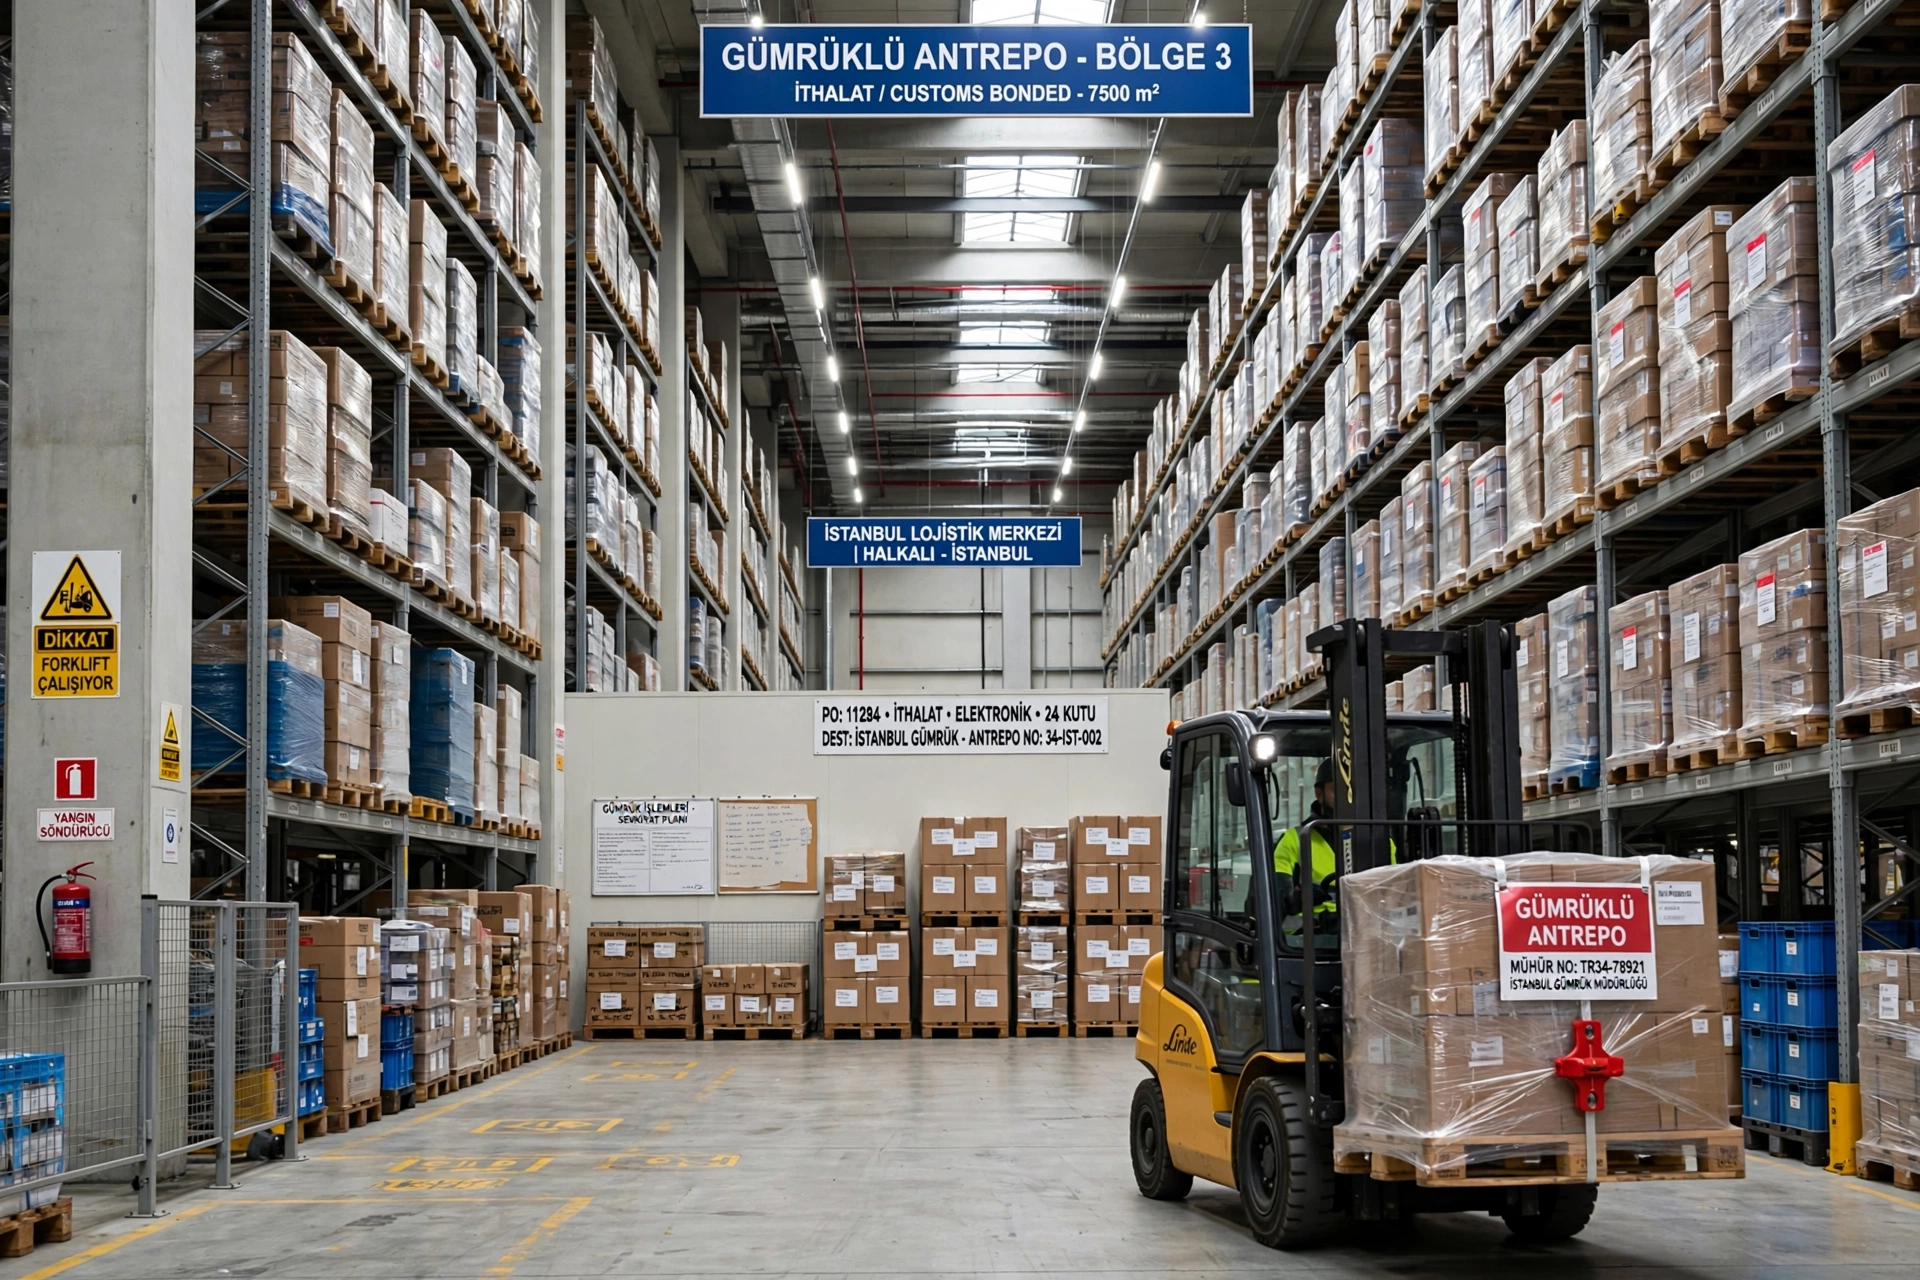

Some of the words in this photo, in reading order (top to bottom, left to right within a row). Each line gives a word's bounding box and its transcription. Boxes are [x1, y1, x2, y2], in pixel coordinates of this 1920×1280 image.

[722, 36, 905, 71] GÜMRÜKLÜ
[914, 42, 1067, 71] ANTREPO
[1096, 36, 1206, 71] BÖLGE
[1215, 42, 1232, 70] 3
[795, 81, 874, 102] İTHALAT
[879, 85, 885, 102] /
[890, 85, 984, 102] CUSTOMS
[990, 85, 1071, 102] BONDED
[1088, 85, 1130, 102] 7500
[825, 523, 906, 541] İSTANBUL
[911, 522, 984, 541] LOJİSTİK
[989, 522, 1062, 541] MERKEZİ
[863, 546, 935, 561] HALKALI
[951, 543, 1033, 561] İSTANBUL
[44, 629, 109, 648] DİKKAT
[41, 657, 110, 672] FORKLIFT
[38, 676, 113, 695] ÇALIŞIYOR
[822, 706, 843, 723] PO:
[893, 702, 943, 723] İTHALAT
[955, 701, 1032, 722] ELEKTRONİK
[1045, 706, 1060, 722] 24
[1064, 705, 1096, 722] KUTU
[822, 730, 853, 747] DEST:
[855, 726, 908, 747] İSTANBUL
[911, 726, 959, 747] GÜMRÜK
[968, 730, 1020, 746] ANTREPO
[1023, 729, 1043, 746] NO:
[1337, 697, 1353, 804] Linde
[54, 812, 95, 824] YANGIN
[40, 824, 111, 838] SÖNDÜRÜCÜ
[1515, 893, 1635, 920] GÜMRÜKLÜ
[1527, 925, 1626, 947] ANTREPO
[1510, 957, 1554, 974] MÜHÜR
[1557, 959, 1578, 974] NO:
[1580, 959, 1645, 974] TR34-78921
[1510, 976, 1552, 990] İSTANBUL
[1554, 976, 1592, 991] GÜMRÜK
[1594, 976, 1648, 990] MÜDÜRLÜĞÜ
[1163, 1023, 1198, 1056] Linde
